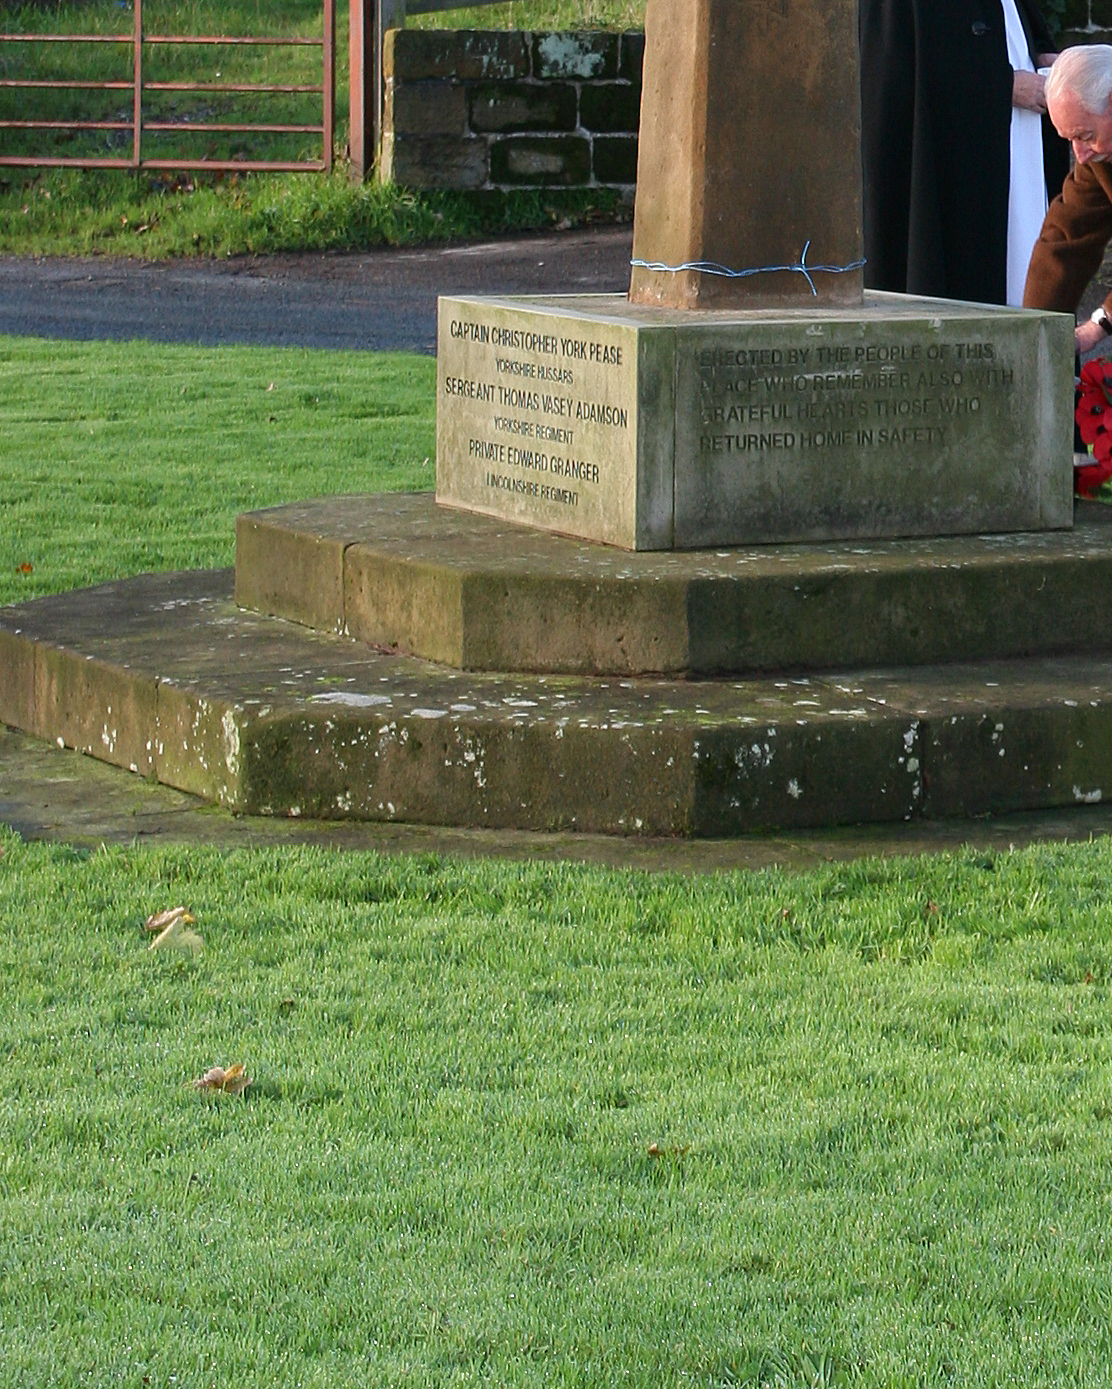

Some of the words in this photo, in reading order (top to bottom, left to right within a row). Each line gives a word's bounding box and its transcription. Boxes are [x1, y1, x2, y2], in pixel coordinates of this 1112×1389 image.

[451, 320, 489, 343] CAPTAIN
[492, 327, 557, 352] CHRISTOPHER
[560, 338, 587, 357] YORK
[590, 343, 623, 365] PEASE
[789, 349, 811, 365] BY
[815, 347, 850, 364] THE
[855, 346, 923, 362] PEOPLE
[927, 344, 951, 360] OF
[954, 343, 994, 359] THIS
[495, 358, 536, 377] YORKSHIRE
[538, 367, 573, 384] HUSSARS
[765, 376, 807, 392] WHO
[813, 373, 911, 391] REMEMBER
[918, 370, 963, 387] ALSO
[971, 368, 1013, 385] WITH
[446, 377, 495, 400] SERGEANT
[498, 387, 539, 411] THOMAS
[542, 395, 573, 417] VASEY
[576, 401, 627, 428] ADAMSON
[797, 401, 868, 418] HEARTS
[874, 399, 932, 416] THOSE
[938, 397, 980, 413] WHO
[494, 416, 533, 437] YORKSHIRE
[536, 425, 574, 445] REGIMENT
[700, 432, 795, 453] RETURNED
[800, 431, 852, 448] HOME
[856, 430, 873, 446] IN
[878, 427, 948, 445] SAFETY
[469, 439, 504, 461] PRIVATE
[508, 448, 548, 471] EDWARD
[550, 457, 599, 483] GRANGER
[541, 484, 578, 506] REGIMENT
